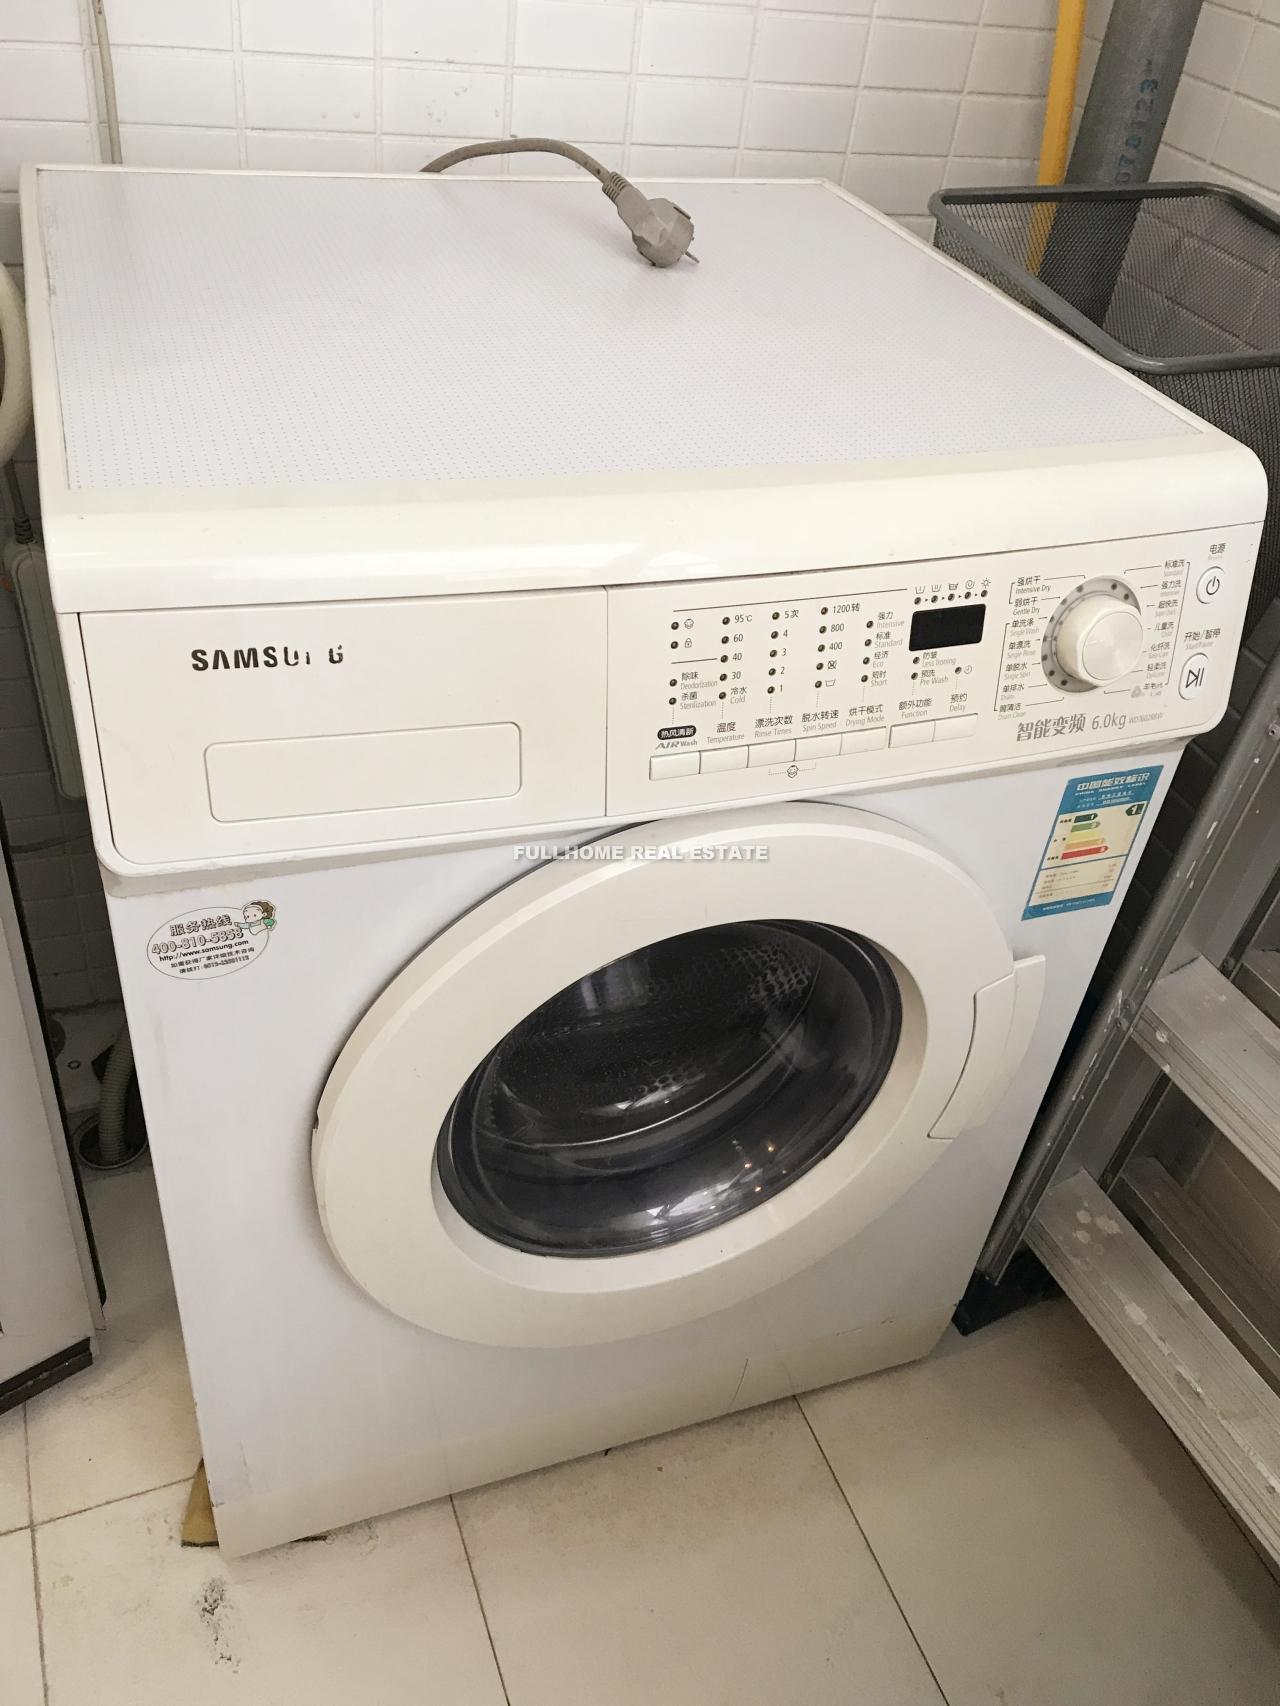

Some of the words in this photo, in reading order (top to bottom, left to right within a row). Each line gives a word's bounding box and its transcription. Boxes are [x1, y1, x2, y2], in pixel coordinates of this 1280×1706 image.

[1210, 543, 1226, 554] 电源
[1017, 576, 1040, 586] 强烘干
[833, 603, 860, 613] 1200转
[1013, 608, 1030, 616] Gentle
[785, 610, 799, 619] 5次
[878, 612, 893, 620] 强力
[831, 624, 844, 632] 800
[877, 621, 905, 629] Intensive
[734, 634, 744, 642] 60
[876, 631, 891, 640] 标准
[1184, 628, 1221, 641] 开始/暂停
[829, 642, 843, 650] 400
[875, 639, 903, 648] Standard
[732, 653, 742, 661] 40
[781, 648, 787, 656] 3
[874, 651, 889, 659] 经济
[682, 672, 698, 681] 除味
[732, 671, 741, 679] 30
[680, 680, 718, 690] Deodorization
[871, 679, 887, 687] Short
[731, 686, 747, 695] 冷水
[730, 696, 745, 704] Cold
[950, 693, 967, 704] 预约
[680, 700, 716, 710] Sterilization
[899, 698, 932, 711] 额外功能
[950, 704, 966, 713] Delay
[849, 704, 883, 717] 烘干模式
[901, 710, 928, 719] Function
[755, 715, 793, 728] 漂洗次数
[802, 710, 839, 723] 脱水转速
[845, 717, 865, 727] Drying
[867, 715, 885, 723] Mode
[1091, 712, 1126, 730] 6.0kg
[717, 722, 736, 733] 温度
[755, 729, 771, 738] Rinse
[774, 726, 792, 735] Times
[802, 724, 817, 733] Spin
[820, 721, 837, 731] Speed
[1016, 713, 1087, 742] 智能变频
[707, 734, 744, 744] Temperature
[655, 742, 679, 750] AIR
[681, 739, 698, 748] Wash
[1076, 773, 1150, 791] 中国能效标识
[170, 914, 232, 936] 服务热线
[152, 927, 244, 955] 400-810-5858
[159, 940, 249, 962] http://www.samsung.com
